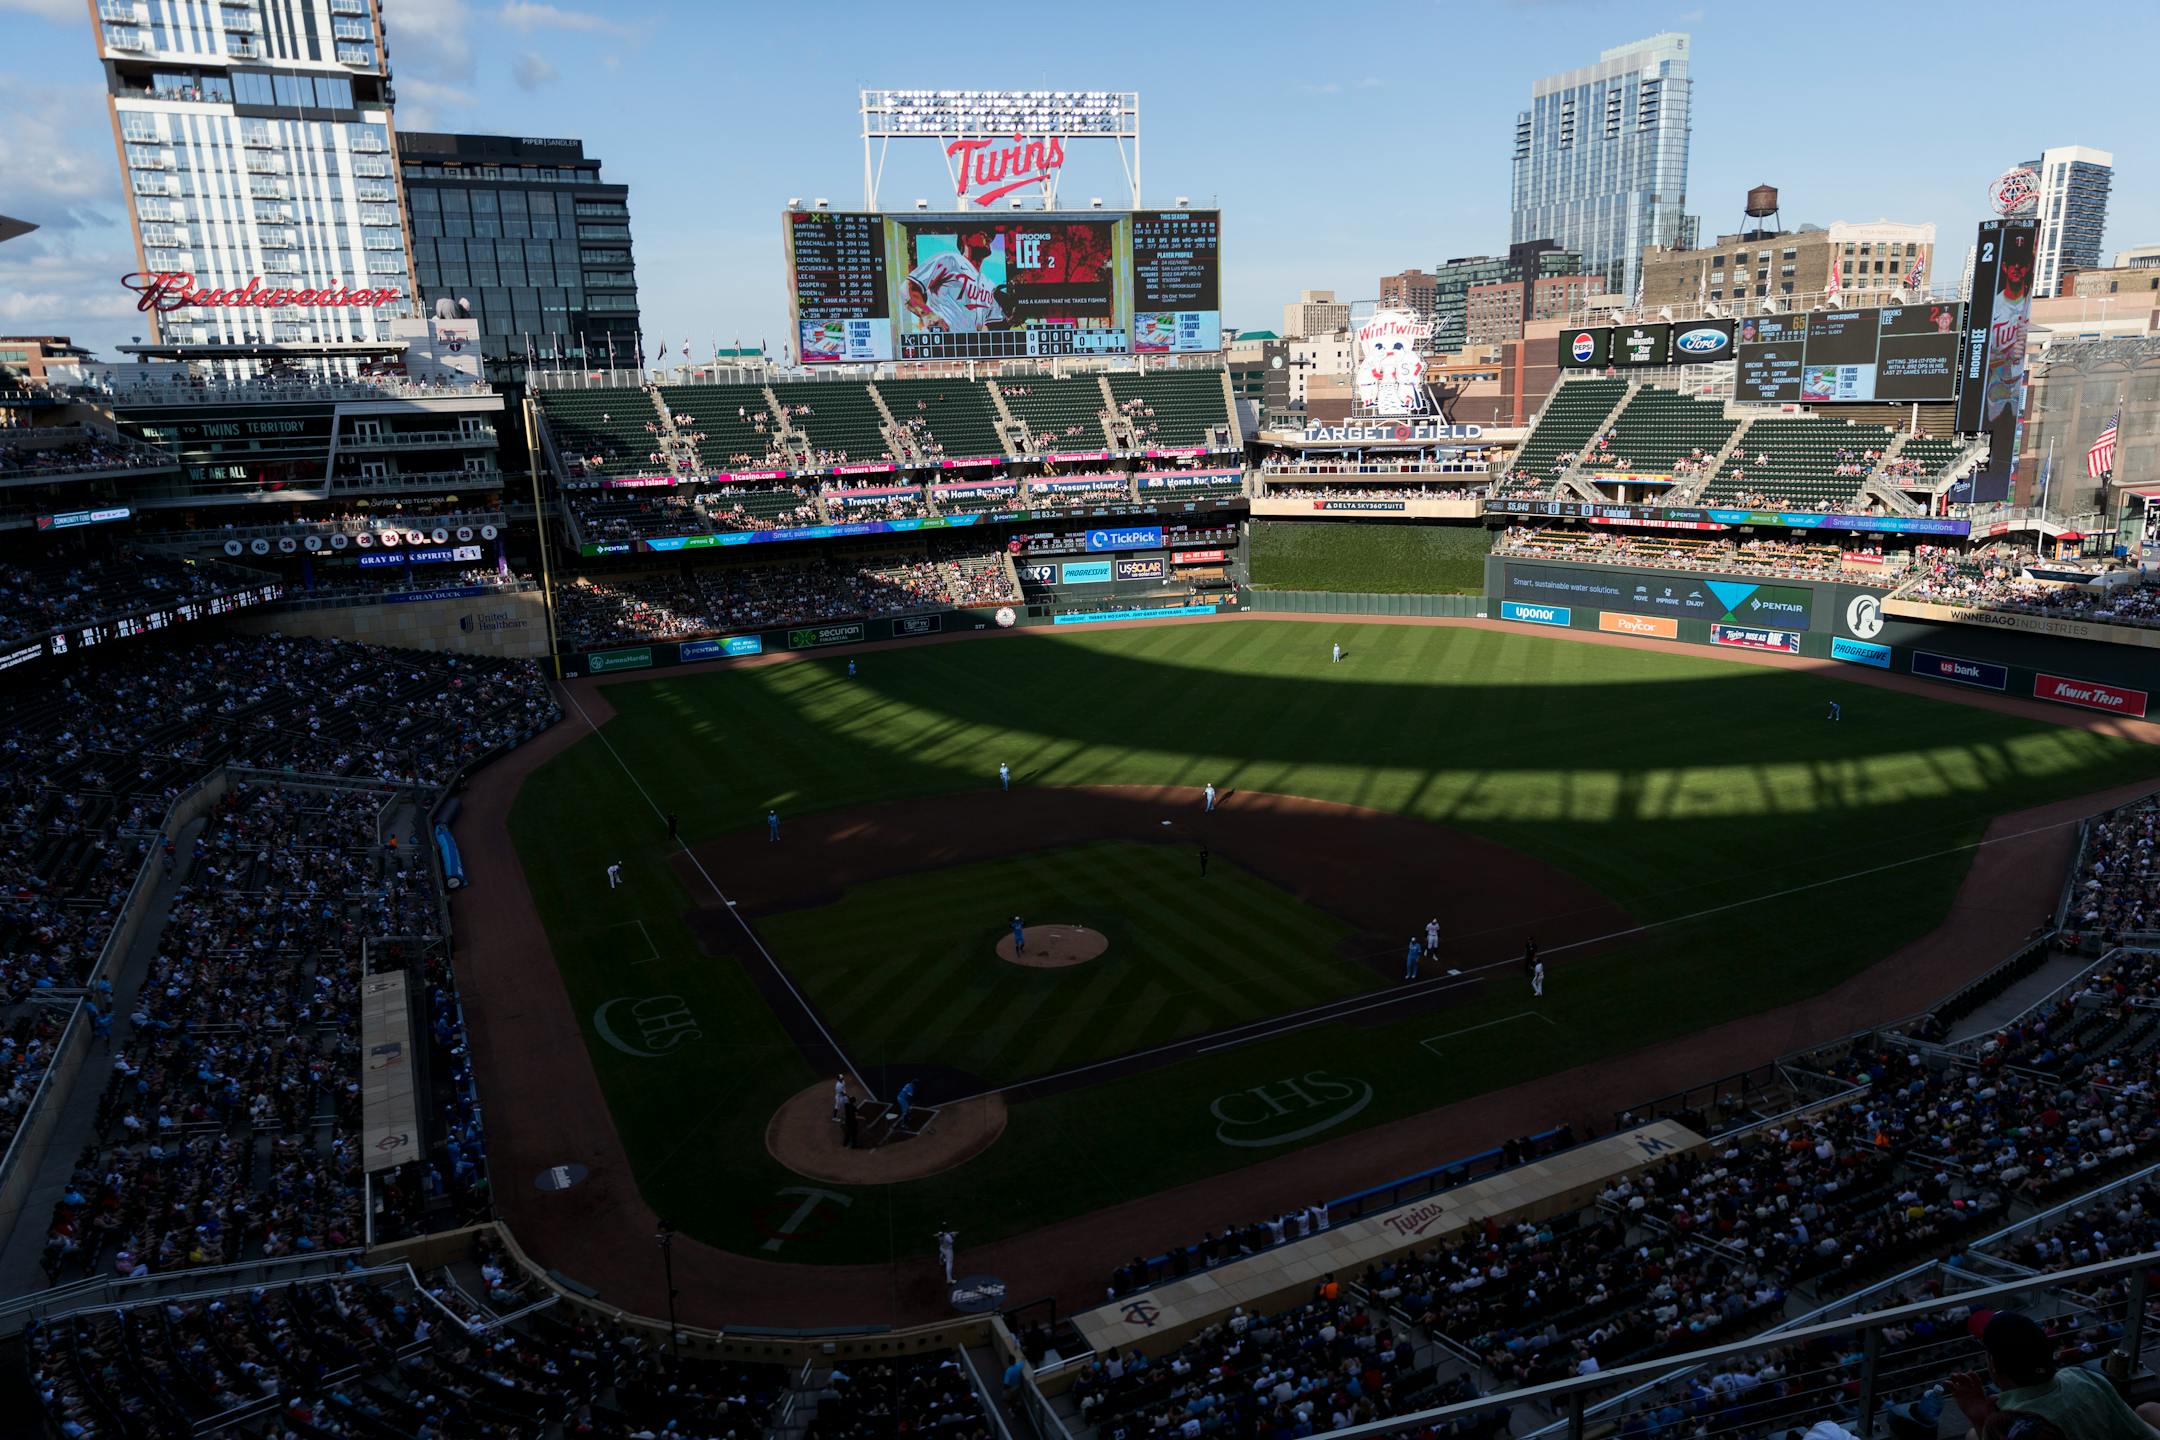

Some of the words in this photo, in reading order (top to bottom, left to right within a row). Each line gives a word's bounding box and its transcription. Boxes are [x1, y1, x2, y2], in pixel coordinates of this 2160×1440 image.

[522, 138, 542, 146] PIPER
[547, 139, 579, 147] SANDLER
[946, 133, 1064, 200] Twins
[1016, 240, 1041, 269] LEE
[1982, 242, 1995, 263] 2
[1048, 256, 1056, 268] 2
[121, 271, 400, 312] Budweiser
[1930, 306, 1939, 322] 2
[1792, 316, 1806, 330] 65
[1882, 316, 1893, 325] LEE
[1358, 322, 1388, 341] Win!
[1390, 319, 1433, 336] Twins!
[1758, 324, 1782, 332] CAMERON
[1633, 330, 1644, 339] The
[1971, 328, 1986, 344] LEE
[1626, 336, 1655, 346] Minnesota
[1686, 334, 1717, 350] Ford
[1637, 346, 1651, 354] Star
[1629, 353, 1650, 361] Tribune
[1969, 343, 1983, 379] BROOKS
[142, 426, 179, 438] WELCOME
[201, 423, 240, 437] TWINS
[246, 420, 305, 434] TERRITORY
[1304, 427, 1394, 441] TARGET
[1414, 424, 1483, 439] FIELD
[1053, 454, 1082, 462] Treasure
[188, 466, 206, 481] WE
[208, 466, 226, 480] ARE
[228, 465, 248, 479] ALL
[839, 466, 869, 474] Treasure
[870, 464, 890, 472] Island
[611, 479, 645, 488] Treasure
[646, 477, 669, 486] Island
[1052, 482, 1090, 492] Treasure
[1092, 481, 1118, 490] Island
[1166, 476, 1192, 486] Home
[1211, 475, 1232, 484] Deck
[950, 489, 970, 499] Home
[994, 486, 1014, 496] Deck
[1953, 481, 1971, 493] Twins
[847, 496, 886, 507] Treasure
[1333, 502, 1356, 510] DELTA
[1384, 502, 1403, 510] SUITE
[1507, 502, 1530, 512] $5,845
[1041, 510, 1056, 518] 83.2
[1551, 504, 1557, 513] 0
[1584, 505, 1590, 515] 0
[1676, 511, 1701, 519] PENTAIR
[1608, 518, 1642, 527] UNIVERSAL
[1642, 520, 1667, 528] SPORTS
[1667, 521, 1698, 529] AUCTIONS
[1833, 518, 1855, 529] Smart,
[1857, 519, 1897, 529] sustainable
[1898, 522, 1919, 530] water
[1920, 523, 1956, 532] solutions.
[772, 531, 794, 540] Smart,
[827, 526, 843, 534] water
[843, 525, 872, 534] solutions.
[1110, 529, 1155, 544] TickPick
[604, 544, 630, 553] PENTAIR
[360, 556, 389, 564] GRAY
[416, 550, 454, 560] SPIRITS
[1041, 566, 1051, 580] 9
[1064, 567, 1109, 577] PROGRESSIVE
[1513, 577, 1534, 588] Smart,
[1534, 580, 1570, 591] sustainable
[1570, 584, 1589, 592] water
[1589, 585, 1620, 595] solutions.
[408, 593, 435, 601] GRAY
[436, 591, 461, 599] DUCK
[1633, 594, 1648, 602] MOVE
[1655, 597, 1679, 605] IMPROVE
[1685, 599, 1704, 608] ENJOY
[1515, 606, 1555, 621] uponor
[1762, 602, 1803, 613] PENTAIR
[477, 612, 508, 622] United
[1950, 609, 2016, 627] WINNEBAGO
[2016, 618, 2089, 637] INDUSTRIES
[479, 619, 528, 631] Healthcare
[1618, 618, 1656, 633] Paycor
[819, 626, 859, 638] securian
[1725, 630, 1745, 640] Twins
[1745, 632, 1757, 640] RISE
[1766, 632, 1784, 646] ONE
[819, 635, 849, 643] FINANCIAL
[52, 645, 68, 655] MLB
[691, 645, 719, 655] PENTAIR
[1833, 643, 1888, 662] PROGRESSIVE
[604, 654, 650, 665] JamesHardie
[1940, 662, 1953, 673] us
[1953, 663, 1980, 678] bank
[630, 994, 704, 1050] CHS
[1209, 1069, 1354, 1126] CHS
[1384, 1202, 1444, 1236] Twins
